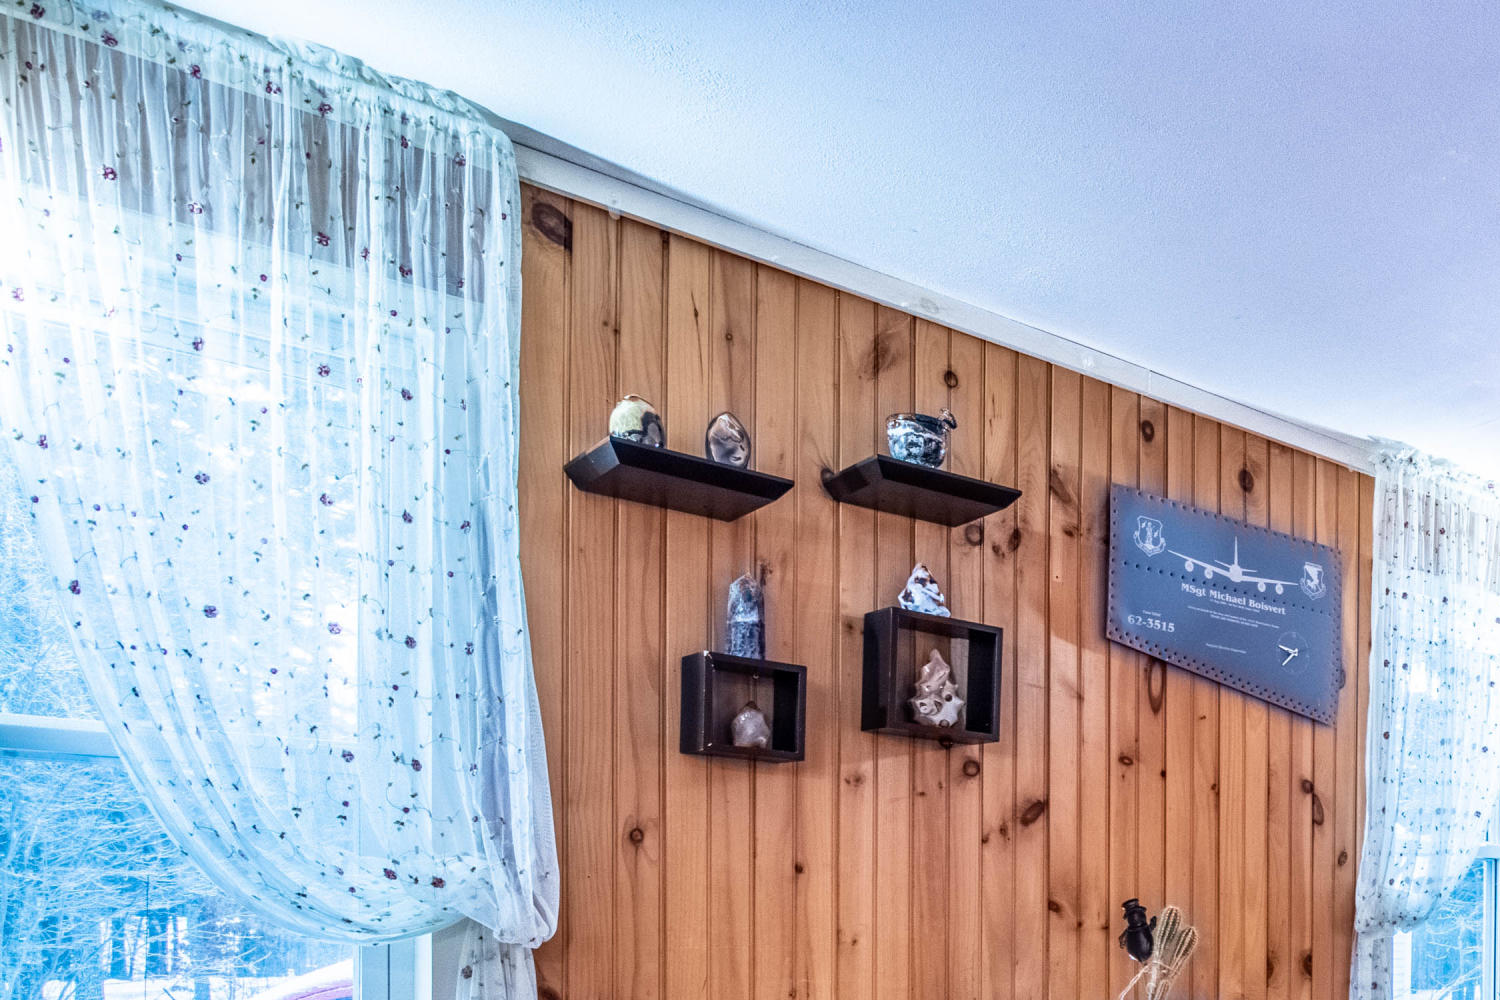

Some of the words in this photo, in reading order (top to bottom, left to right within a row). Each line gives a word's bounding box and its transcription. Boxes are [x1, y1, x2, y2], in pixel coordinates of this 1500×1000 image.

[1181, 583, 1206, 597] MSgt
[1209, 590, 1246, 605] Michael
[1248, 599, 1287, 615] Boisvert
[1127, 614, 1175, 633] 62-3515
